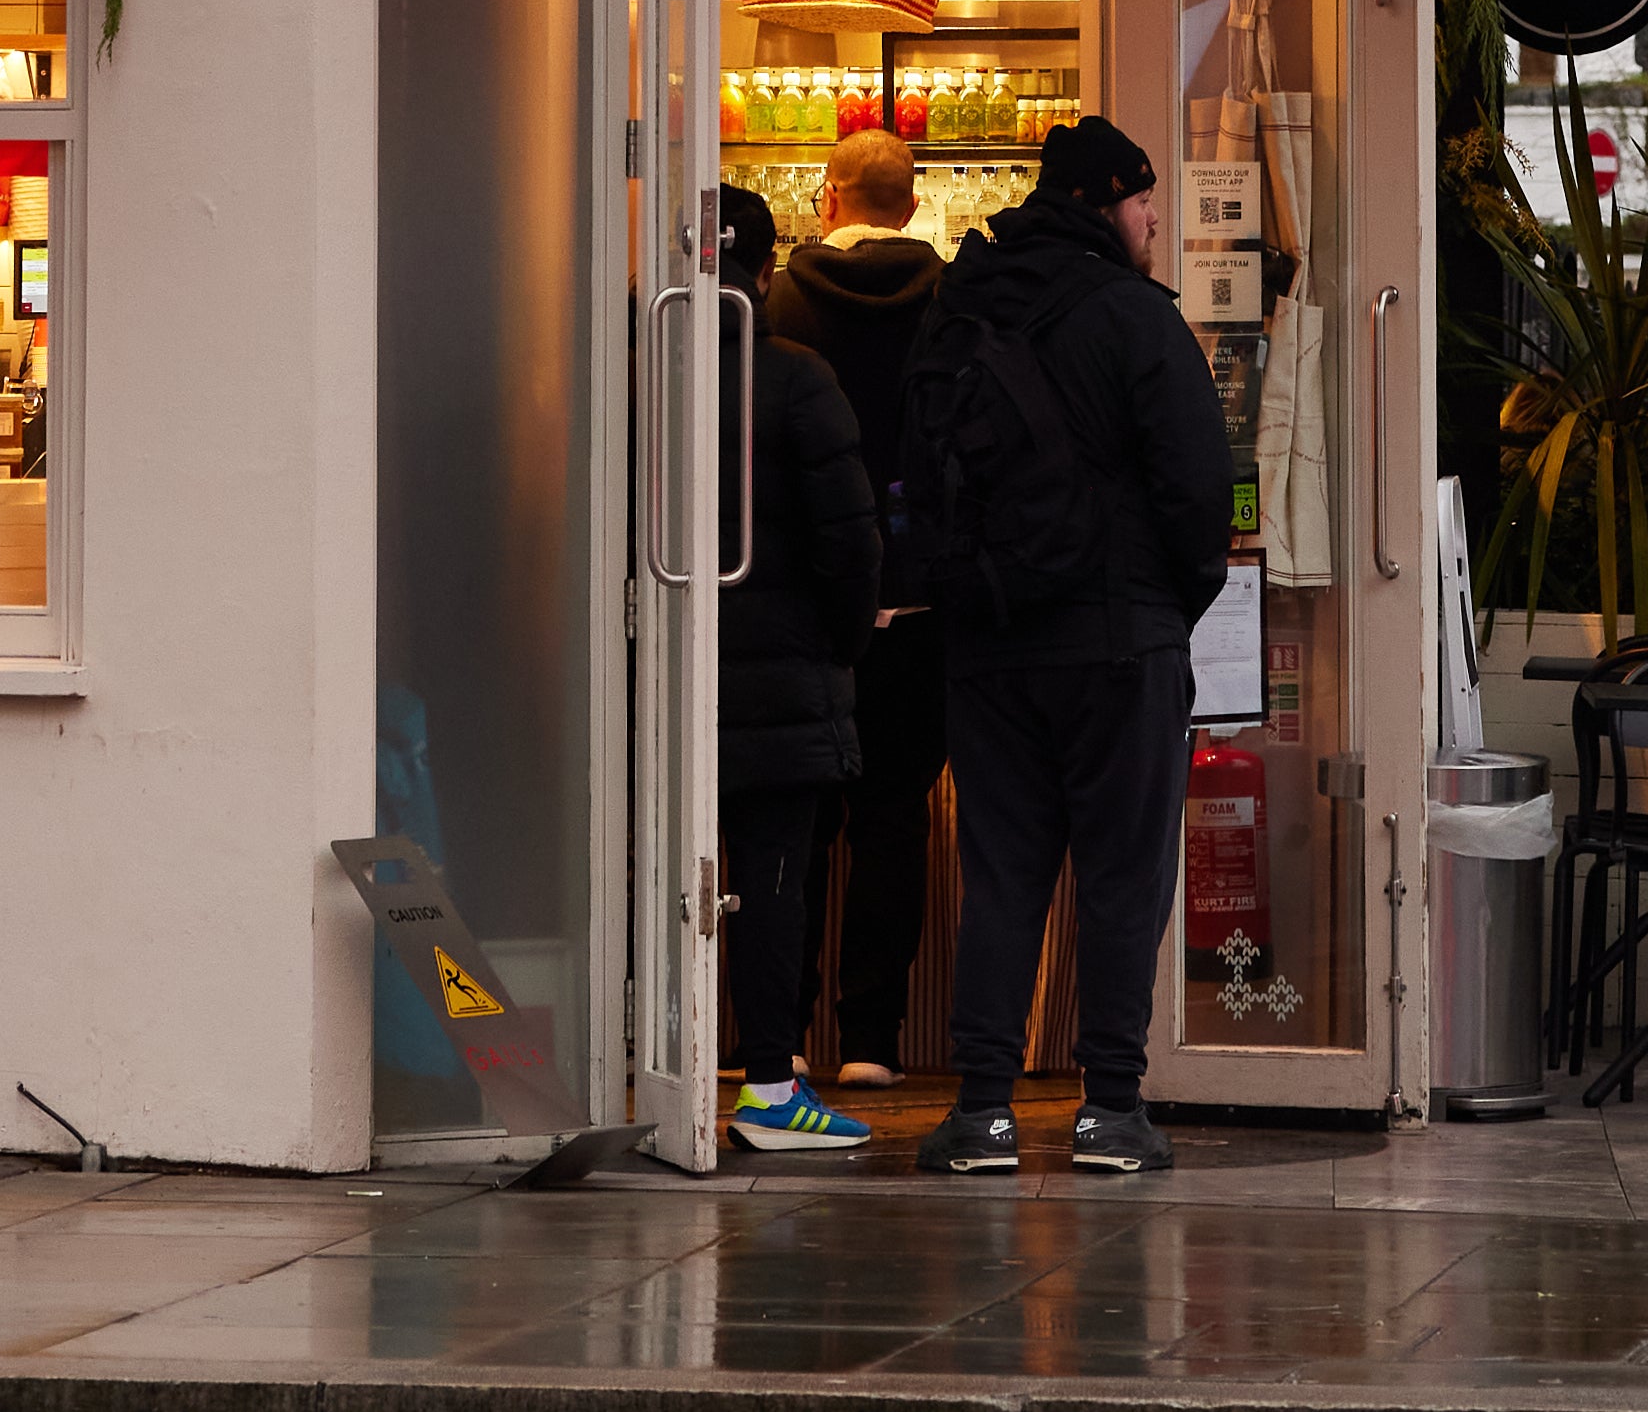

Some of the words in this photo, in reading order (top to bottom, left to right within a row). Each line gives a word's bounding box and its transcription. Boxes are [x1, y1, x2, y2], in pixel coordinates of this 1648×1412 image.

[1191, 169, 1233, 178] DOWNLOAD
[1234, 169, 1250, 177] OUR
[1197, 178, 1227, 186] LOYALTY
[1228, 178, 1244, 186] APP
[1194, 260, 1211, 268] JOIN
[1212, 260, 1228, 268] OUR
[1230, 260, 1249, 268] TEAM
[1243, 506, 1250, 519] 5
[1202, 802, 1236, 815] FOAM
[1194, 897, 1226, 907] KURT
[1229, 895, 1256, 905] FIRE
[388, 906, 444, 923] CAUTION
